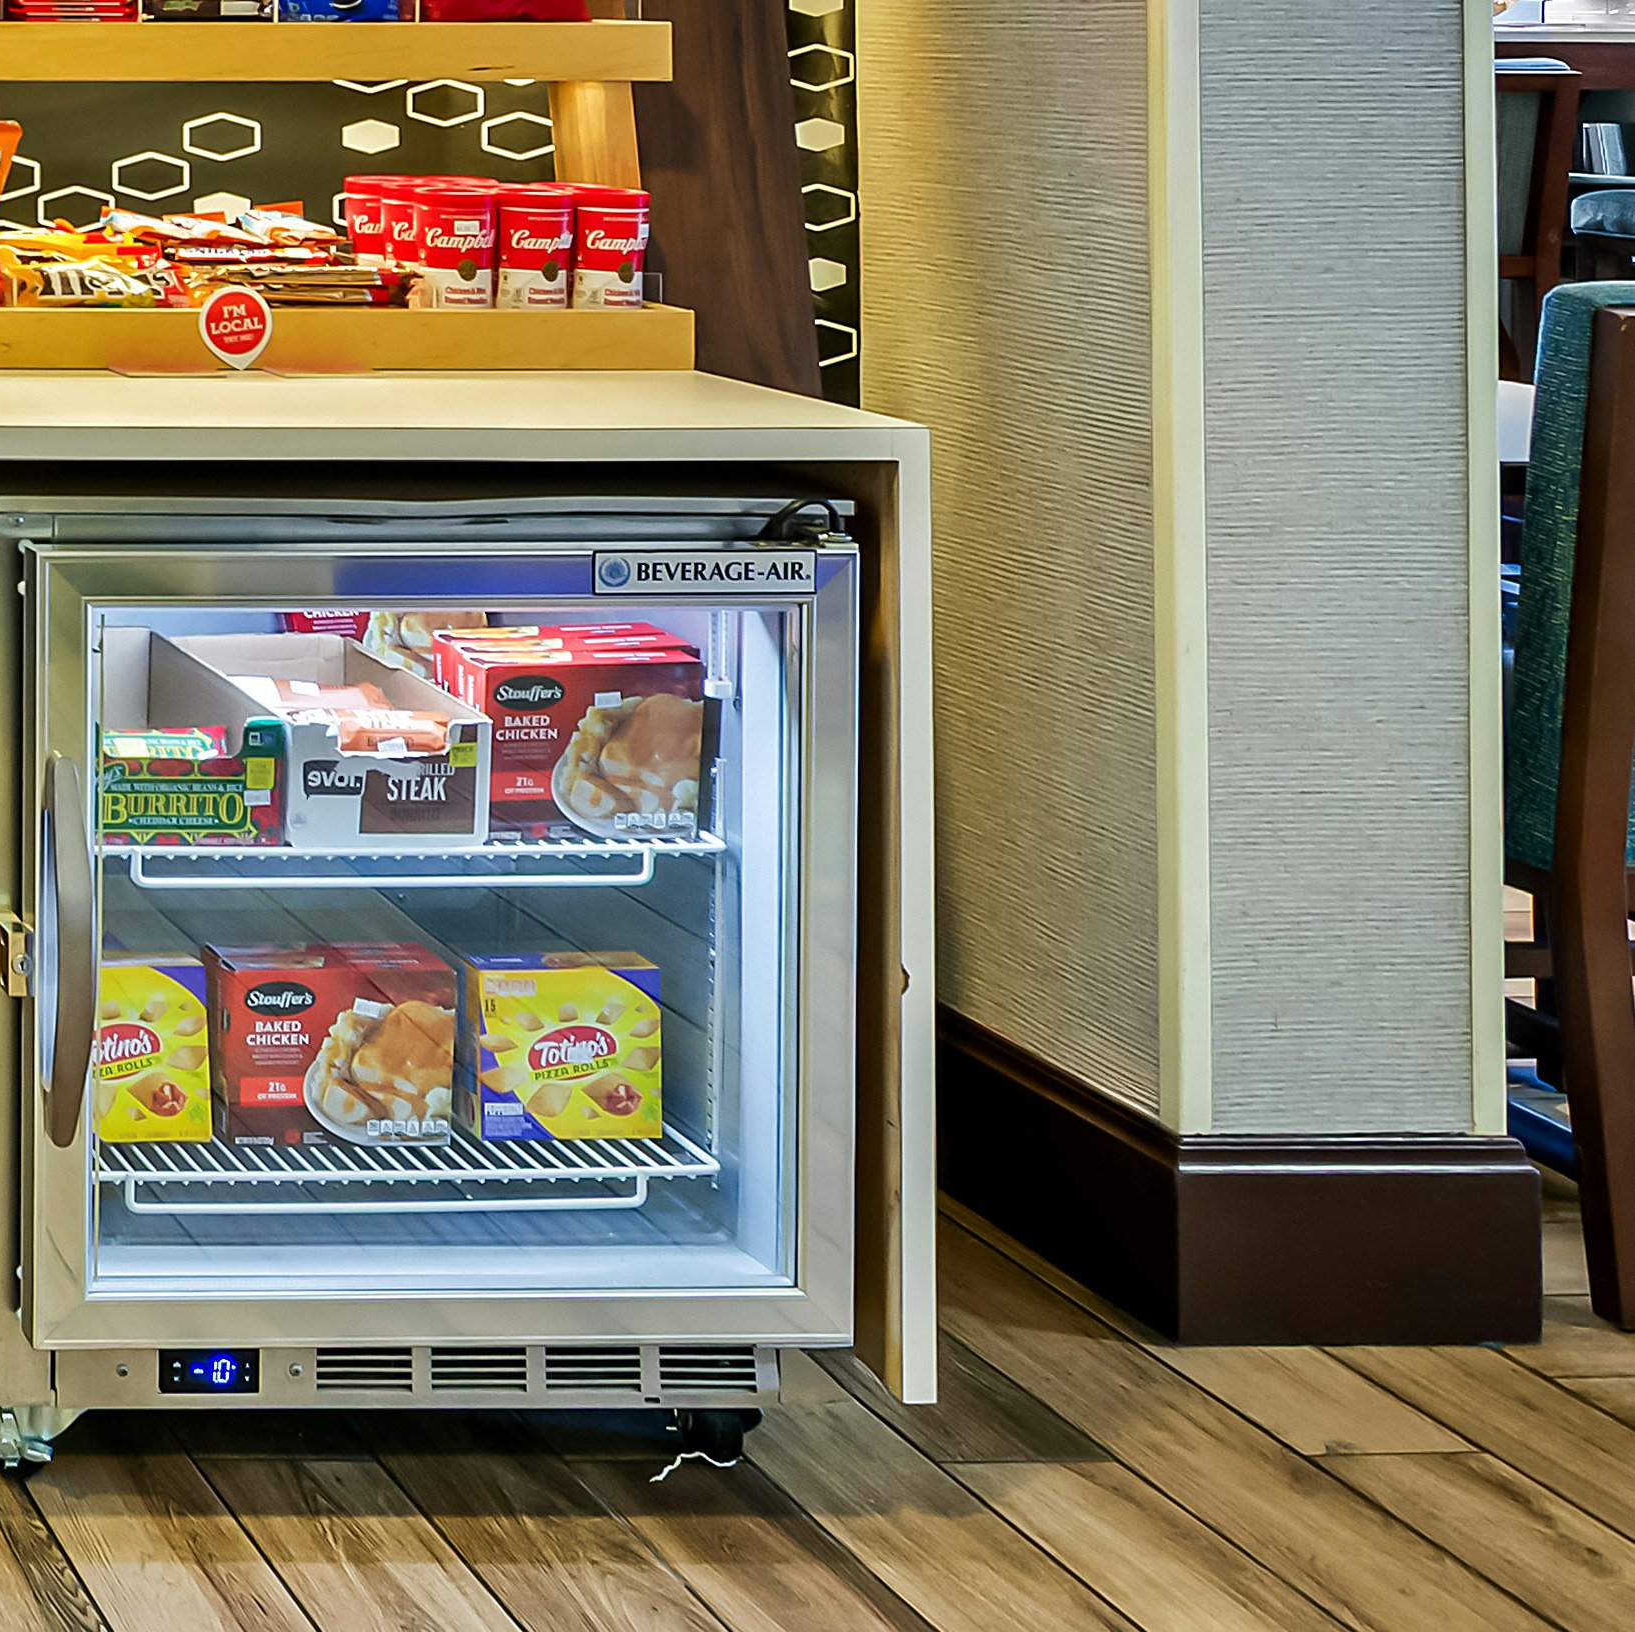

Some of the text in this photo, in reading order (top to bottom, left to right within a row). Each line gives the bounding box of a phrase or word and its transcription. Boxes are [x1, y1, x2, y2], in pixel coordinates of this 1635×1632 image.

[223, 304, 247, 319] I'M
[209, 318, 264, 336] LOCAL
[636, 561, 805, 584] BEVERAGE-AIR
[496, 685, 562, 702] Stouffer's
[505, 715, 550, 727] BAKED
[496, 728, 558, 741] CHICKEN
[418, 762, 455, 777] RILLED
[387, 777, 447, 802] STEAK
[102, 792, 244, 825] BURRITO
[246, 988, 314, 1009] Stouffer's
[484, 998, 496, 1012] 15
[255, 1020, 302, 1033] BAKED
[92, 1030, 153, 1064] otino's
[245, 1033, 310, 1046] CHICKEN
[115, 1058, 153, 1073] ROLLS
[534, 1058, 610, 1081] PIZZA ROLLS
